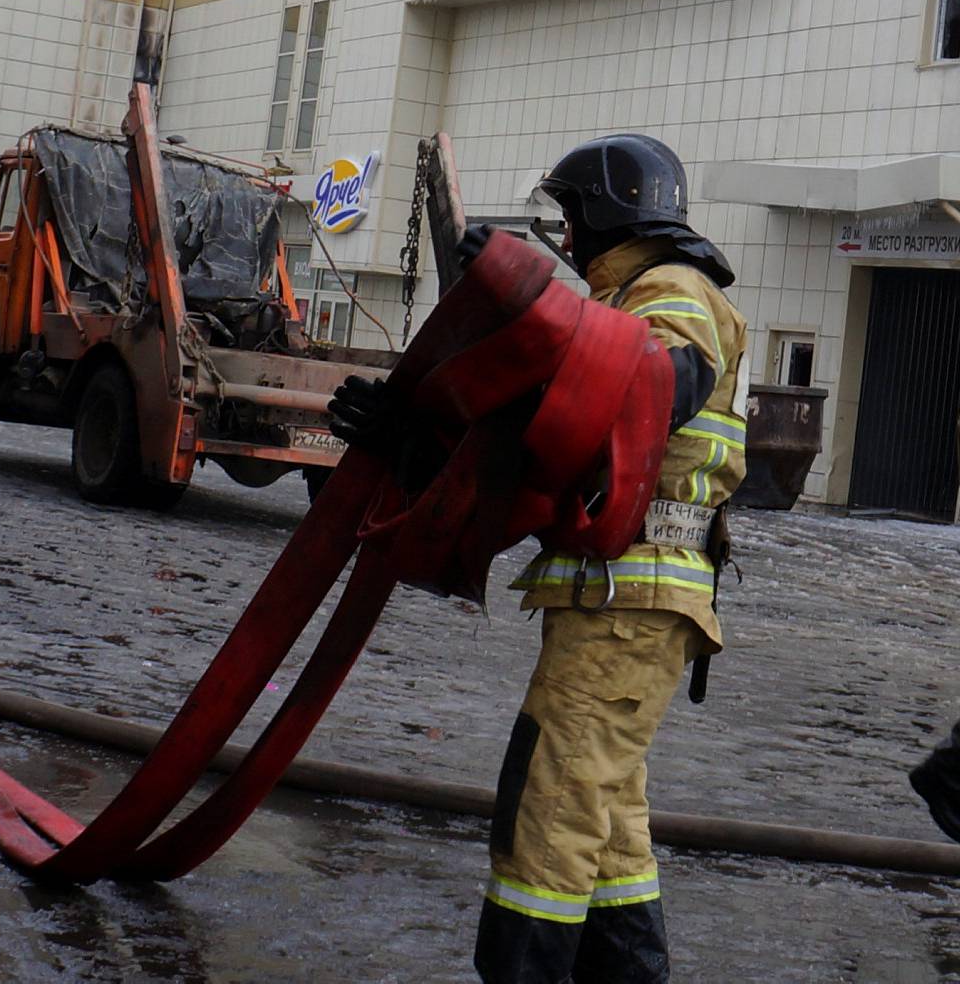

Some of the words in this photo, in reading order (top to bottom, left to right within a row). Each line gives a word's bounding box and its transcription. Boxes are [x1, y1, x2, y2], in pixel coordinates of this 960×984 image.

[313, 155, 372, 222] Ярче!
[867, 234, 902, 252] МЕСТО
[903, 235, 960, 253] РАЗГРУЗКИ
